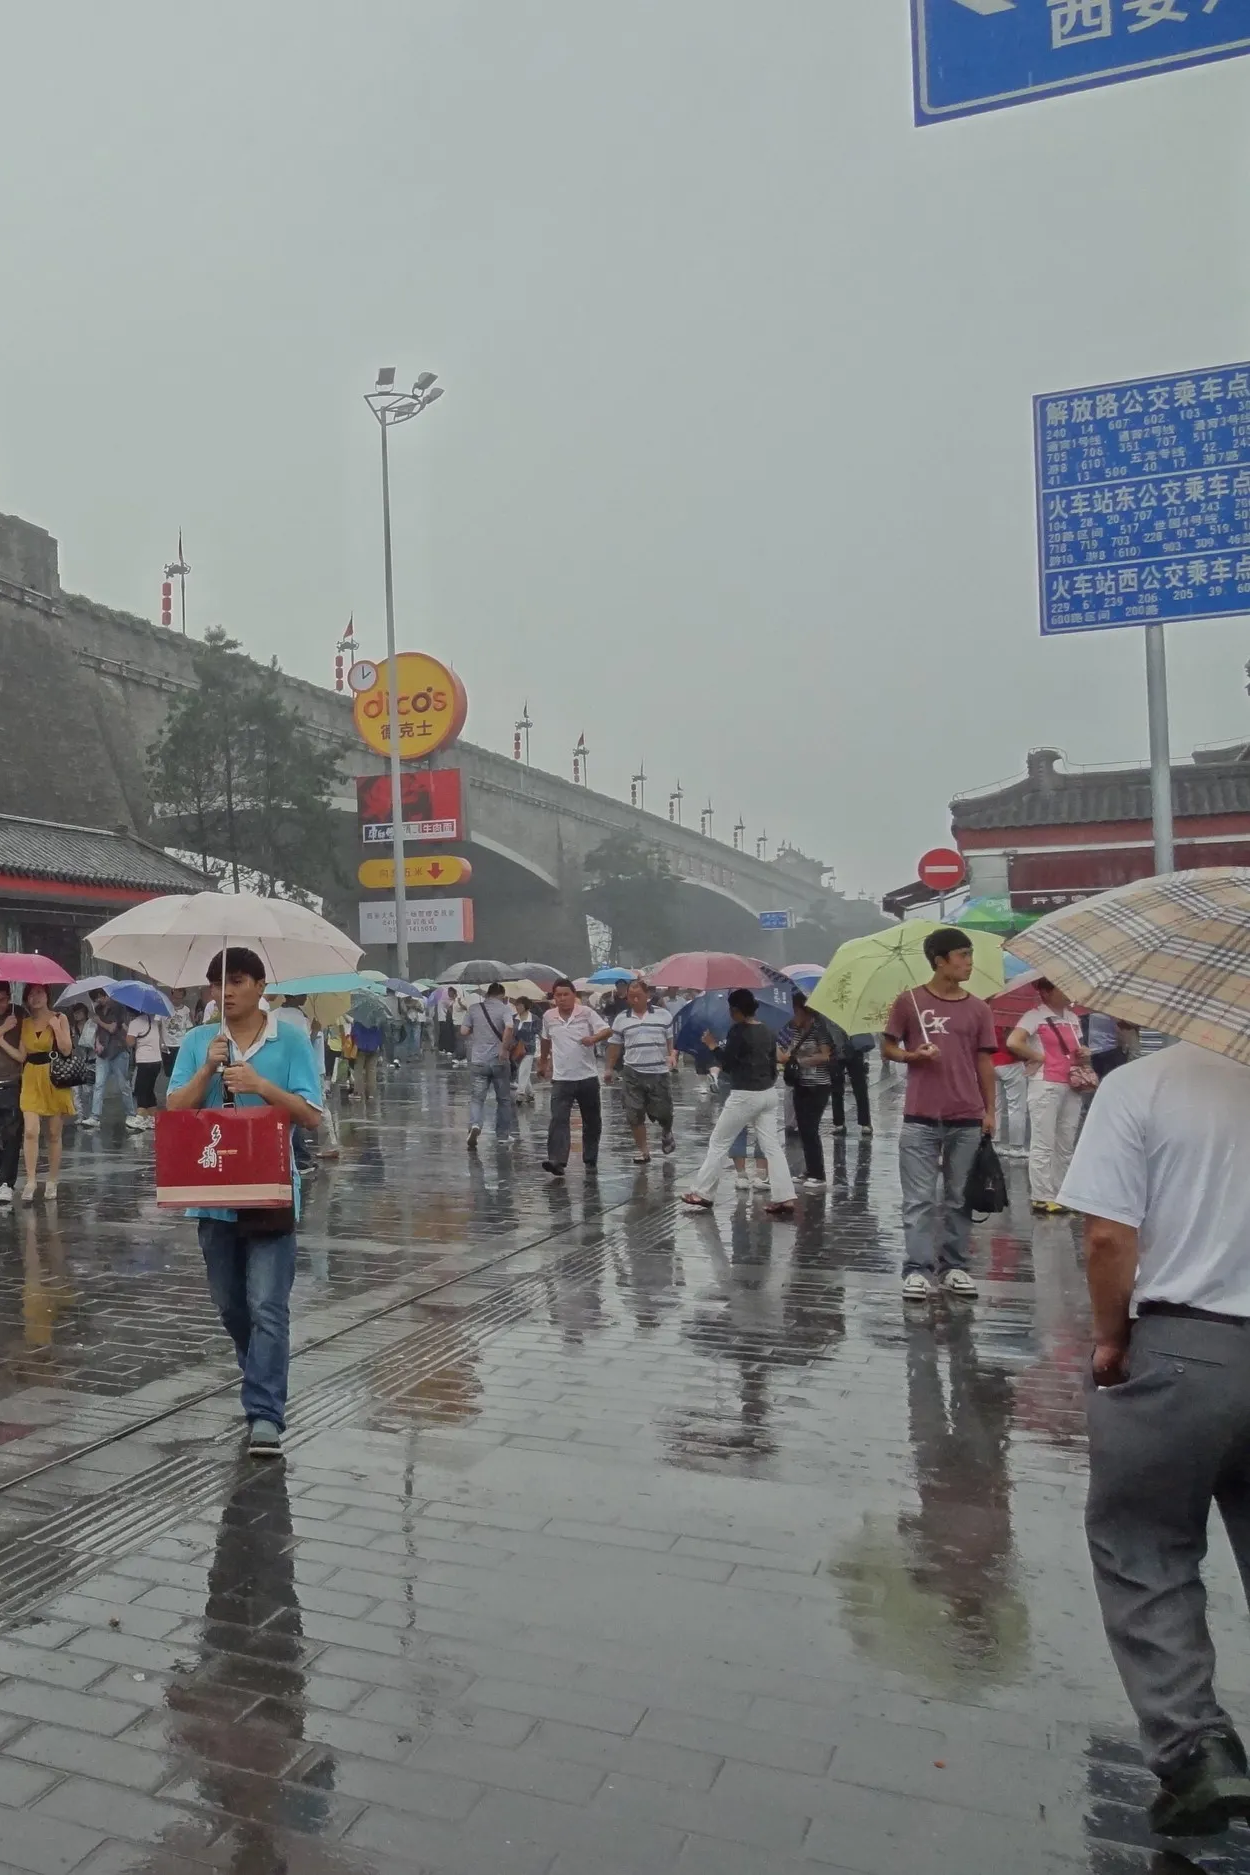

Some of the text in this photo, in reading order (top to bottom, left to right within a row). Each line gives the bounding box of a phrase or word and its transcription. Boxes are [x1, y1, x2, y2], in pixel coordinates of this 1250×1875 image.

[1045, 371, 1250, 427] 解放路公交乘车点
[1048, 468, 1250, 521] 火车站东公交乘车点
[1050, 552, 1250, 603] 火车站西公交乘车点
